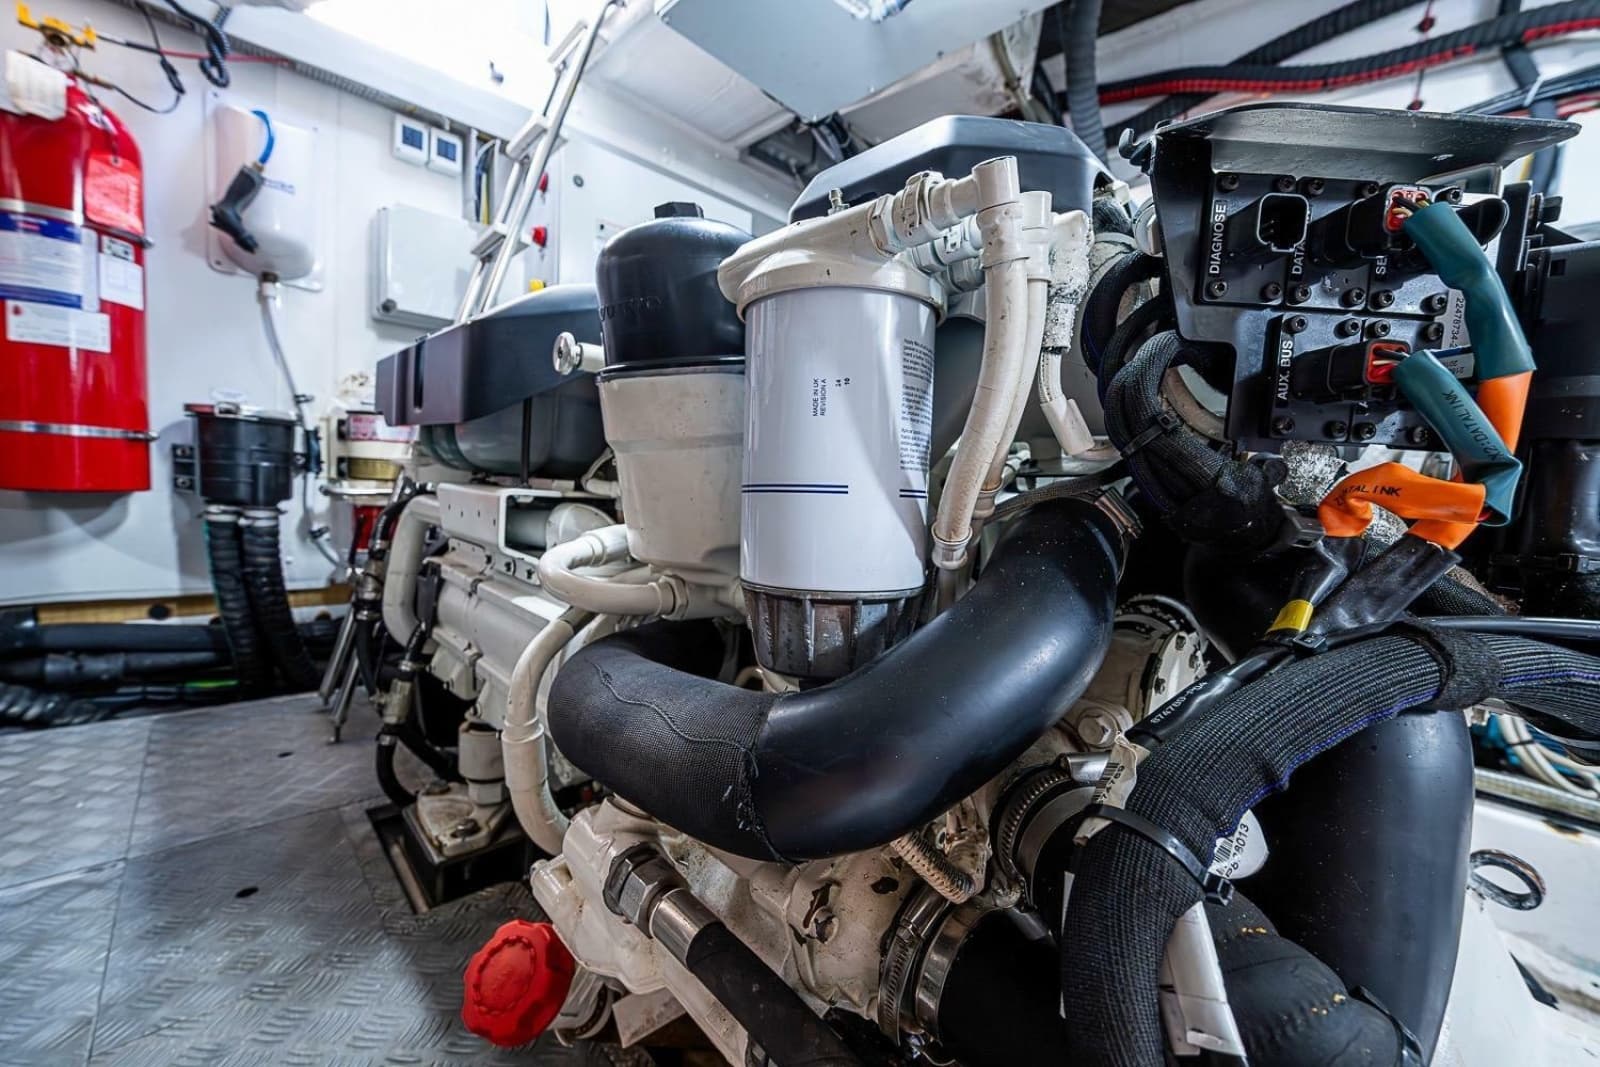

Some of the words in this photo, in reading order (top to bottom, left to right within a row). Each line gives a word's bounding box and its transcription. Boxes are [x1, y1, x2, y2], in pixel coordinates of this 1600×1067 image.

[1209, 204, 1227, 274] DIAGNOSE
[1280, 340, 1294, 367] BUS
[813, 377, 819, 388] UK
[1277, 370, 1290, 400] AUX.
